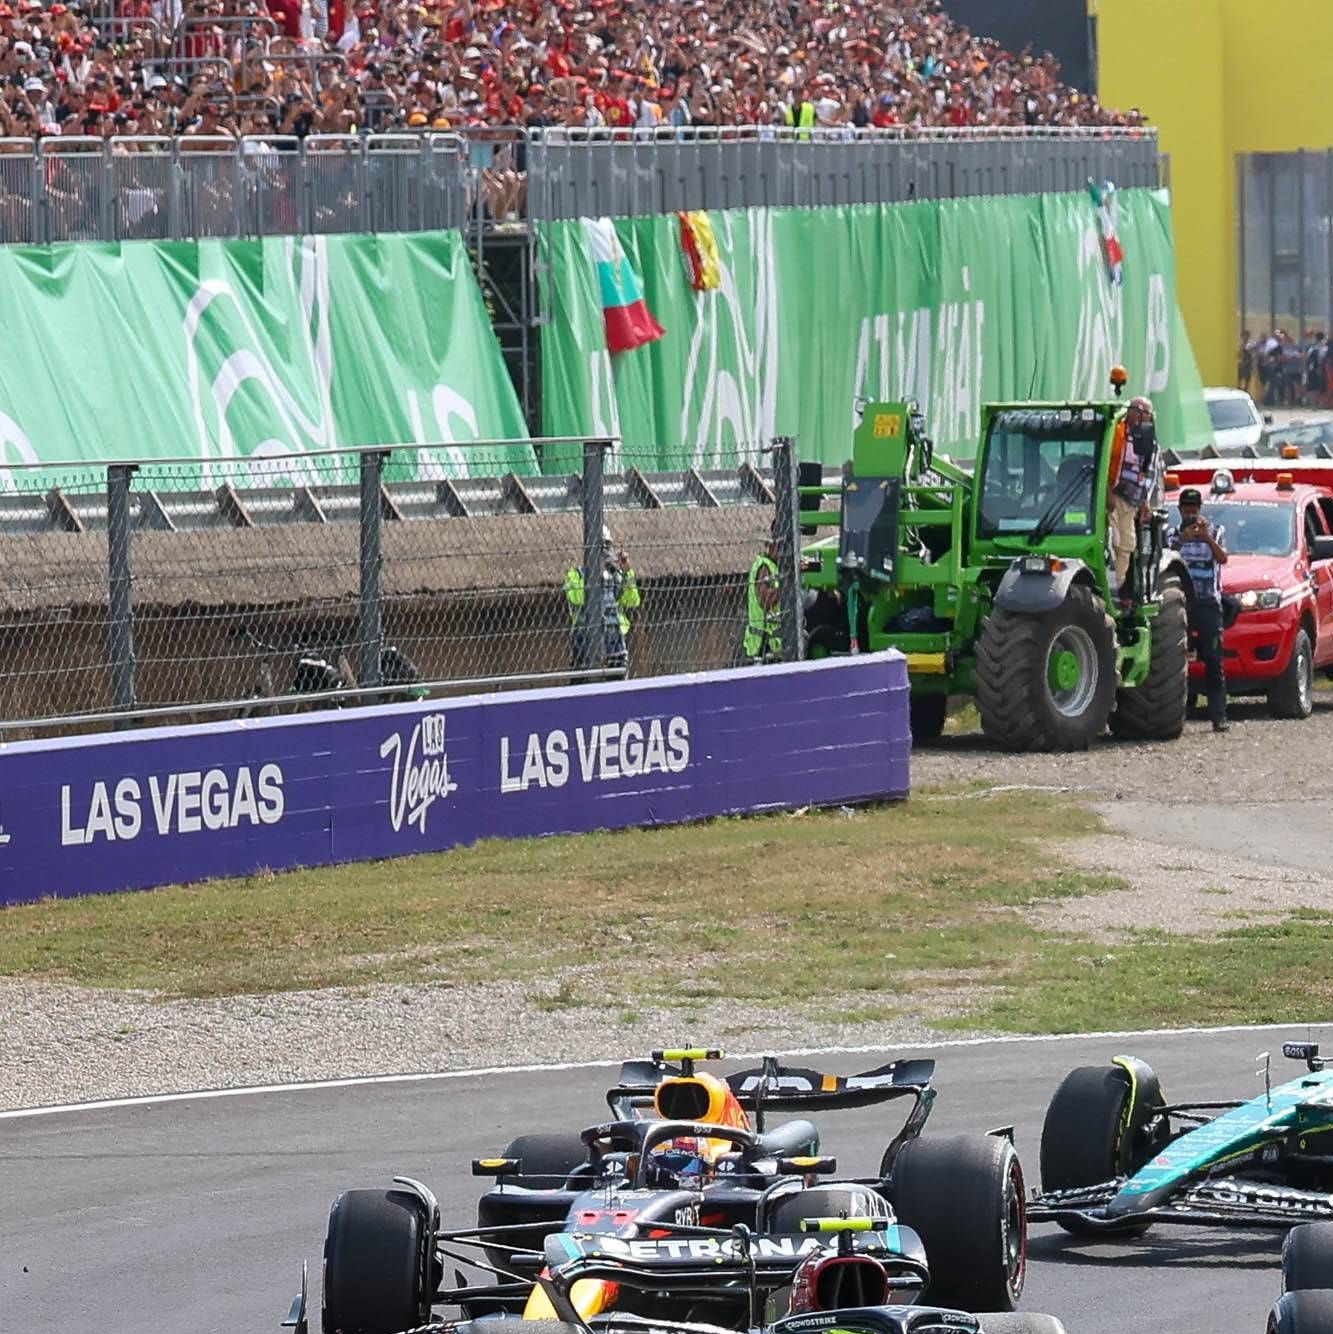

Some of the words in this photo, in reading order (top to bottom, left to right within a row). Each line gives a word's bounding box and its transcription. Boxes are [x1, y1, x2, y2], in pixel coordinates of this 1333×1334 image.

[422, 713, 446, 755] LAS
[500, 731, 571, 794] LAS
[574, 715, 690, 783] VEGAS
[61, 780, 142, 847] LAS
[147, 763, 285, 837] VEGAS
[380, 723, 457, 836] Vegas
